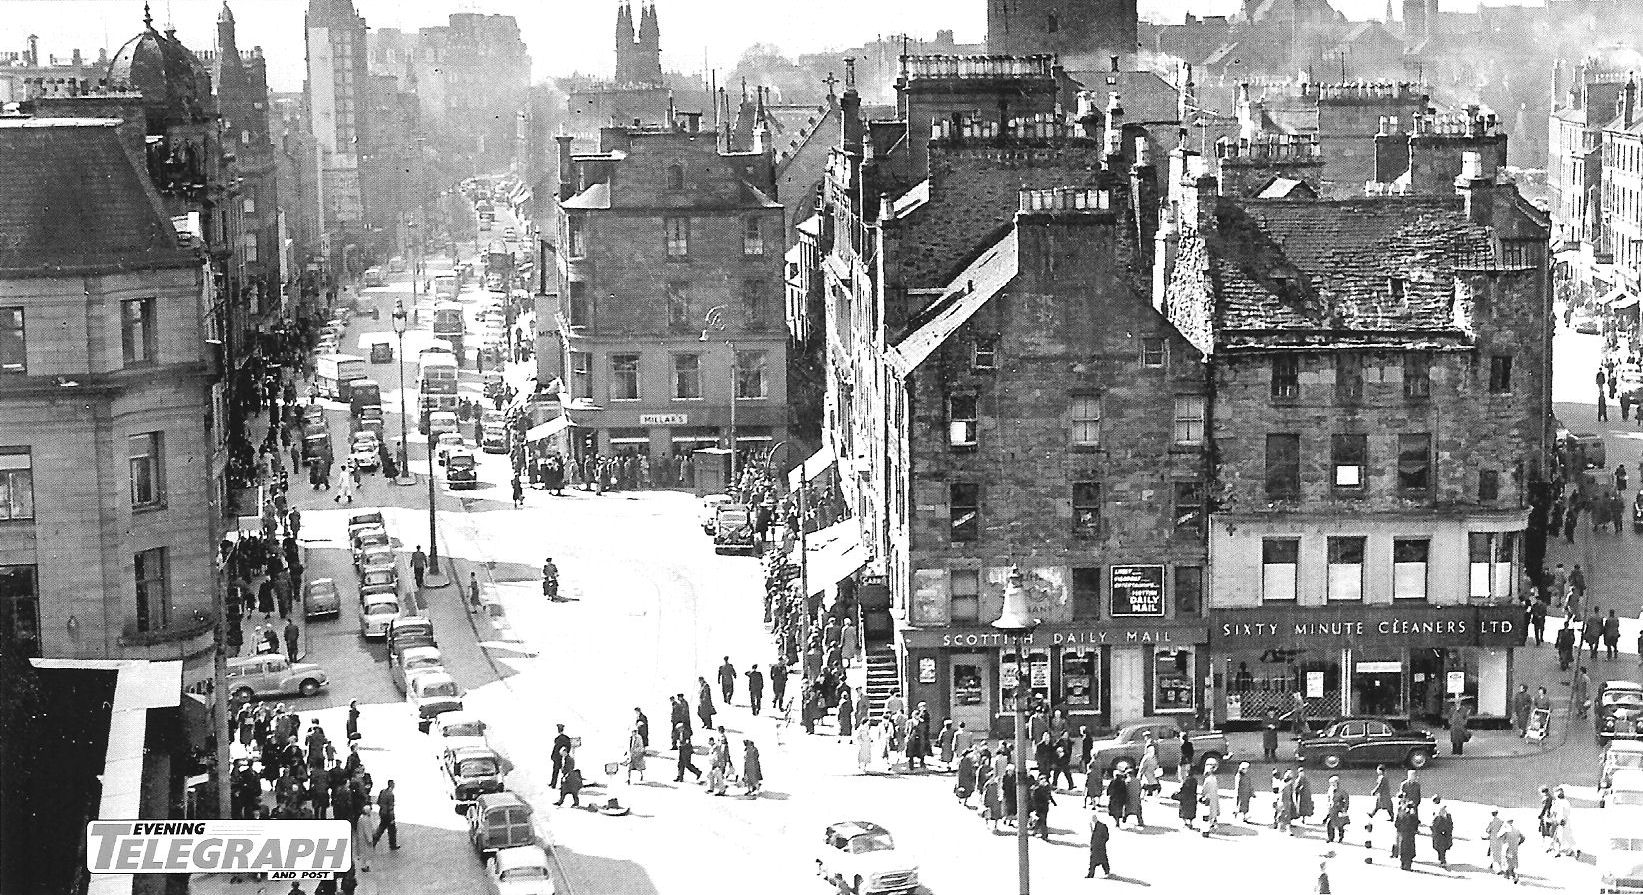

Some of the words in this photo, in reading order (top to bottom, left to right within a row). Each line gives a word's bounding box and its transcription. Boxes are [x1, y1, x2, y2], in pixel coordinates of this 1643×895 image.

[1129, 596, 1160, 604] DAILY
[1131, 604, 1158, 612] MAIL
[1223, 623, 1279, 637] SIXTY
[1294, 622, 1363, 636] MINUTE
[1378, 620, 1467, 635] CLEANERS
[1481, 620, 1514, 633] LTD
[1054, 631, 1108, 645] DAILY
[1126, 630, 1171, 643] MAIL
